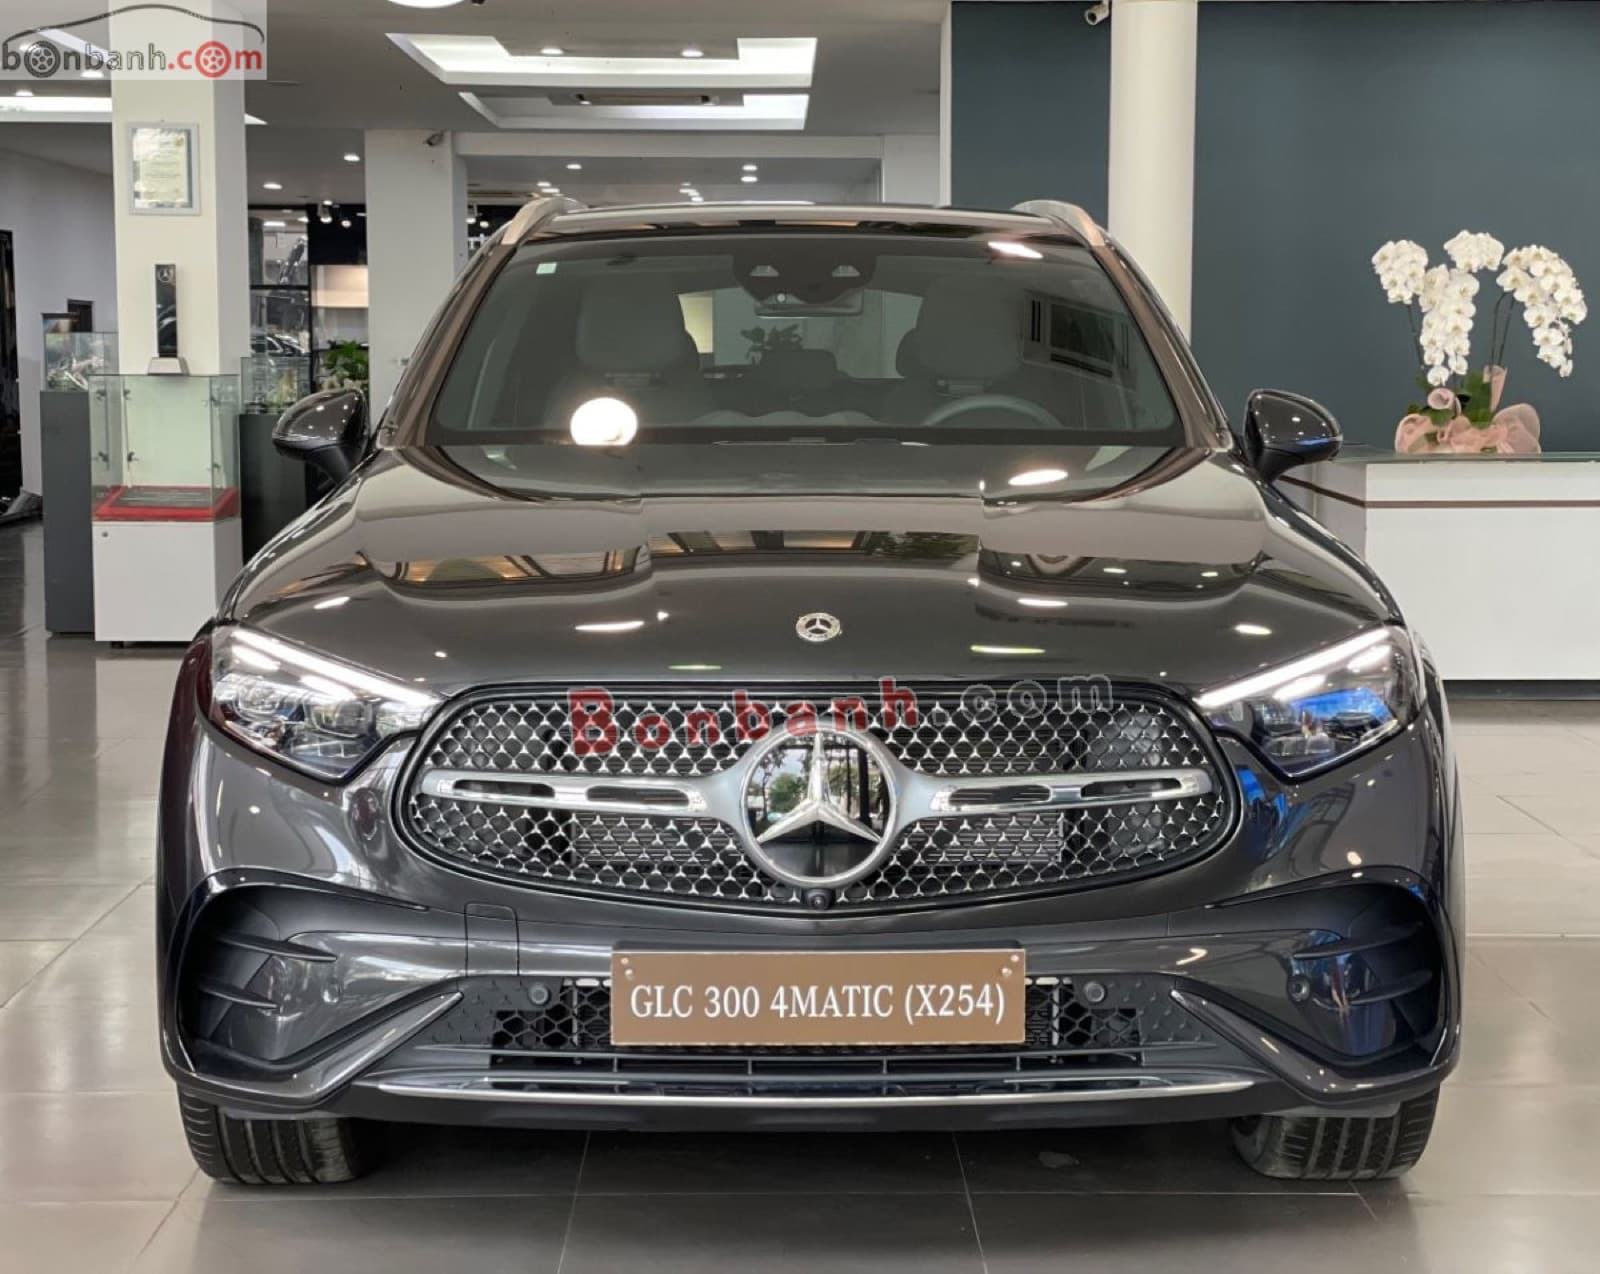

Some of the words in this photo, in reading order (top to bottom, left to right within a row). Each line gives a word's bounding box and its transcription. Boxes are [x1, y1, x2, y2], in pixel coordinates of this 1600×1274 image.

[630, 985, 693, 1018] GLC
[704, 985, 760, 1018] 300
[770, 984, 893, 1018] 4MATIC
[904, 983, 1005, 1024] (X254)
